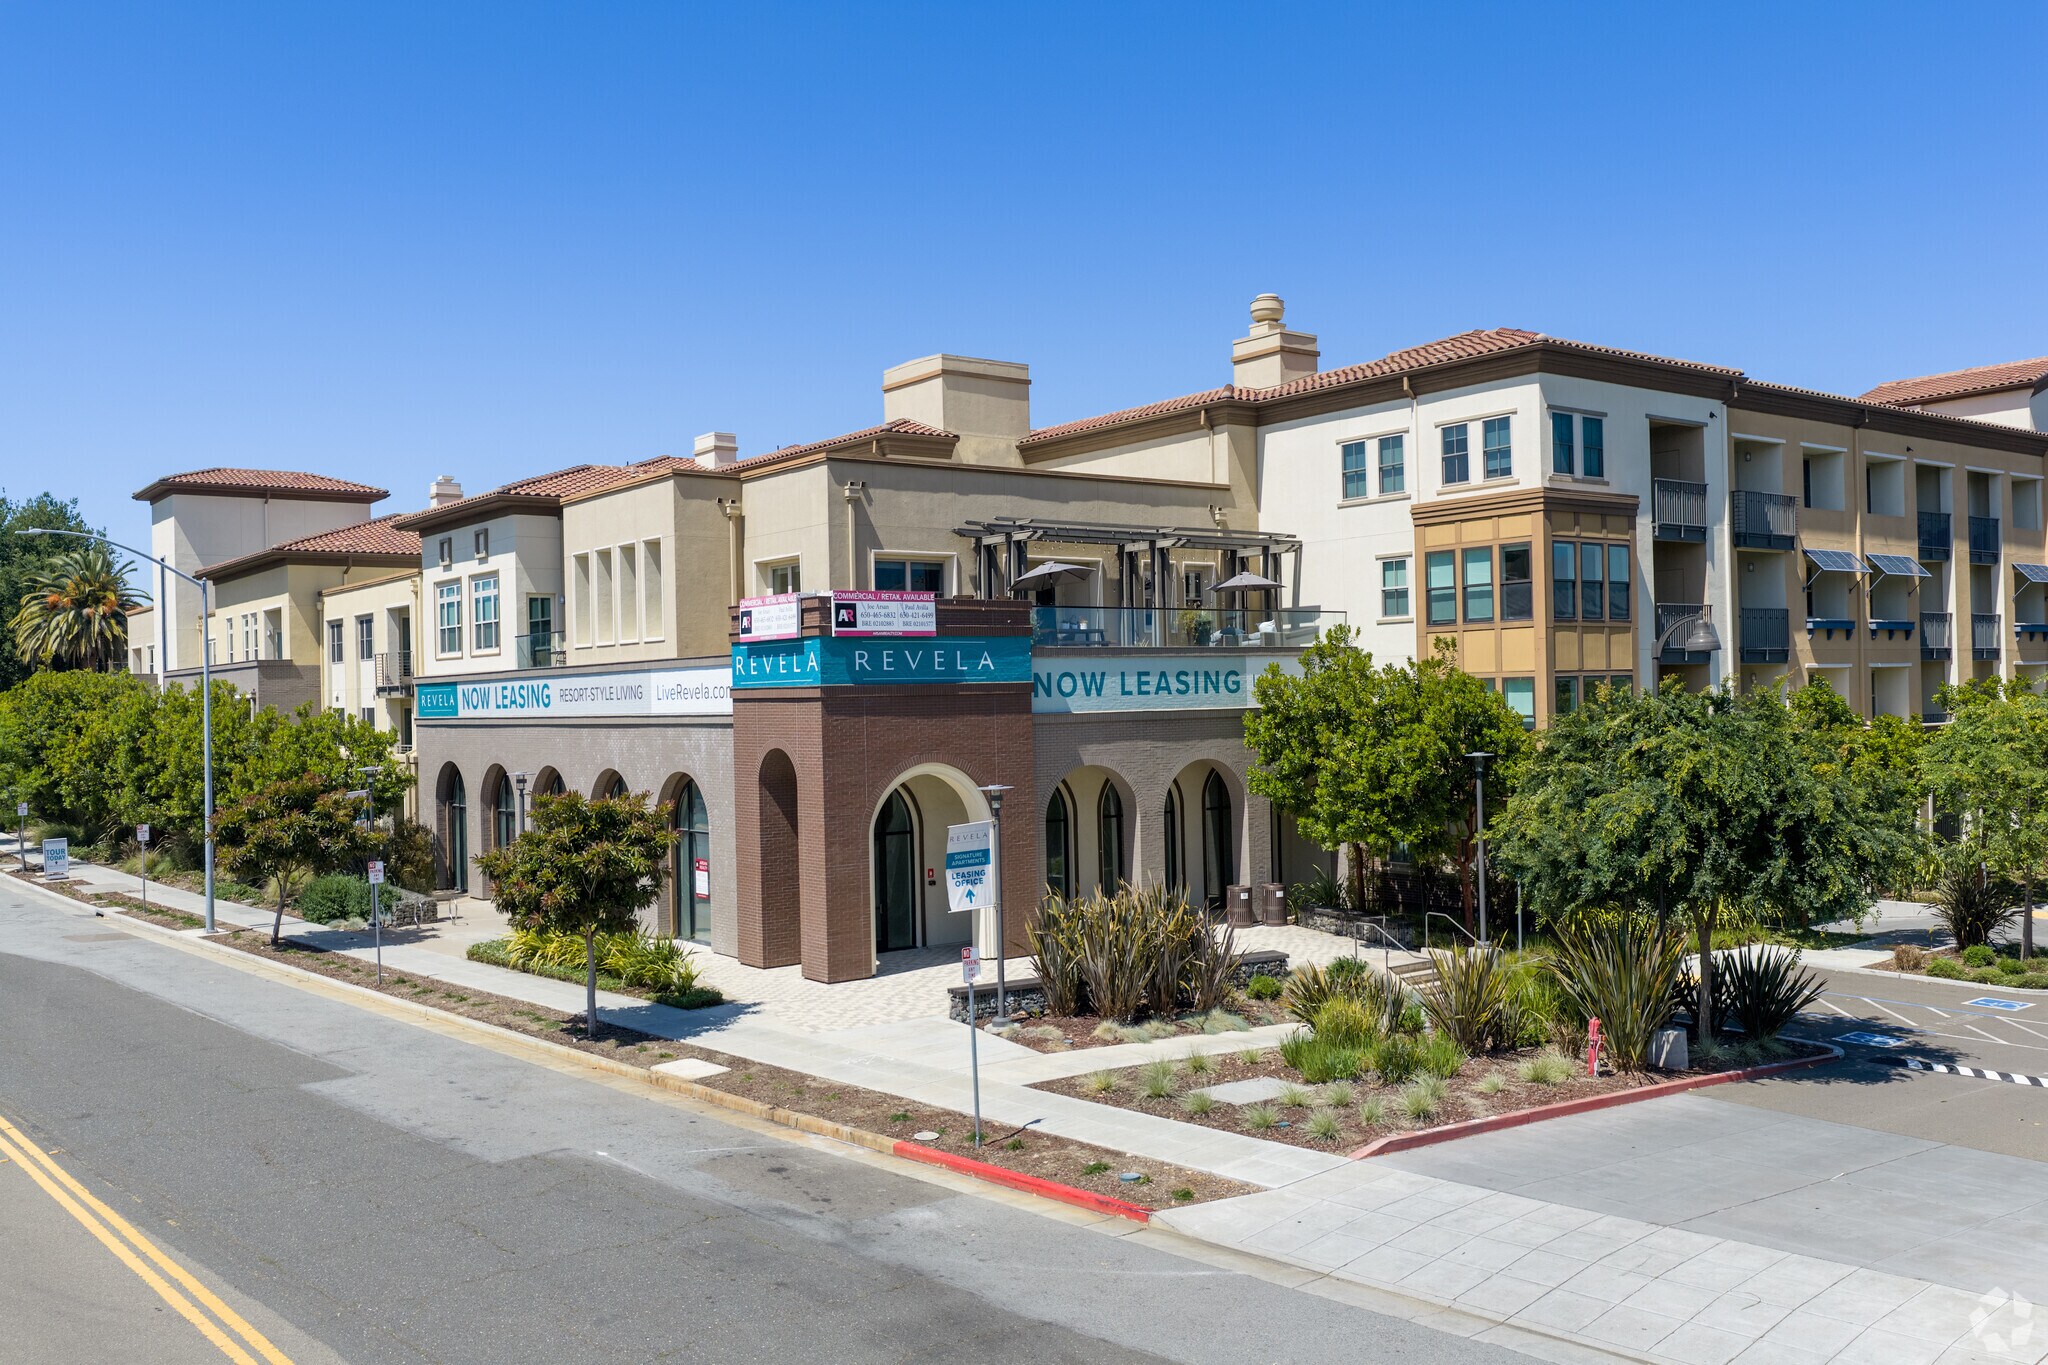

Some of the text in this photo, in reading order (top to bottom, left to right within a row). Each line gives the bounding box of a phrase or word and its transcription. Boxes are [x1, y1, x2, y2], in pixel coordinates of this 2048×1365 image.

[832, 592, 876, 600] COMMERCIAL
[902, 593, 935, 601] AVAILABLE
[838, 608, 855, 622] AR
[736, 651, 818, 676] REVELA
[854, 650, 995, 670] REVELA
[1033, 671, 1106, 698] NOW
[1120, 670, 1241, 696] LEASING
[462, 682, 550, 710] NOW LEASING
[559, 684, 643, 702] RESORT-STYLE LIVING
[421, 694, 455, 708] REVELA
[950, 834, 988, 842] REVELA
[952, 858, 986, 866] APARTMENTS
[954, 852, 982, 860] SIGNATURE
[952, 870, 986, 880] LEASING
[954, 878, 984, 888] OFFICE
[963, 949, 970, 958] NO
